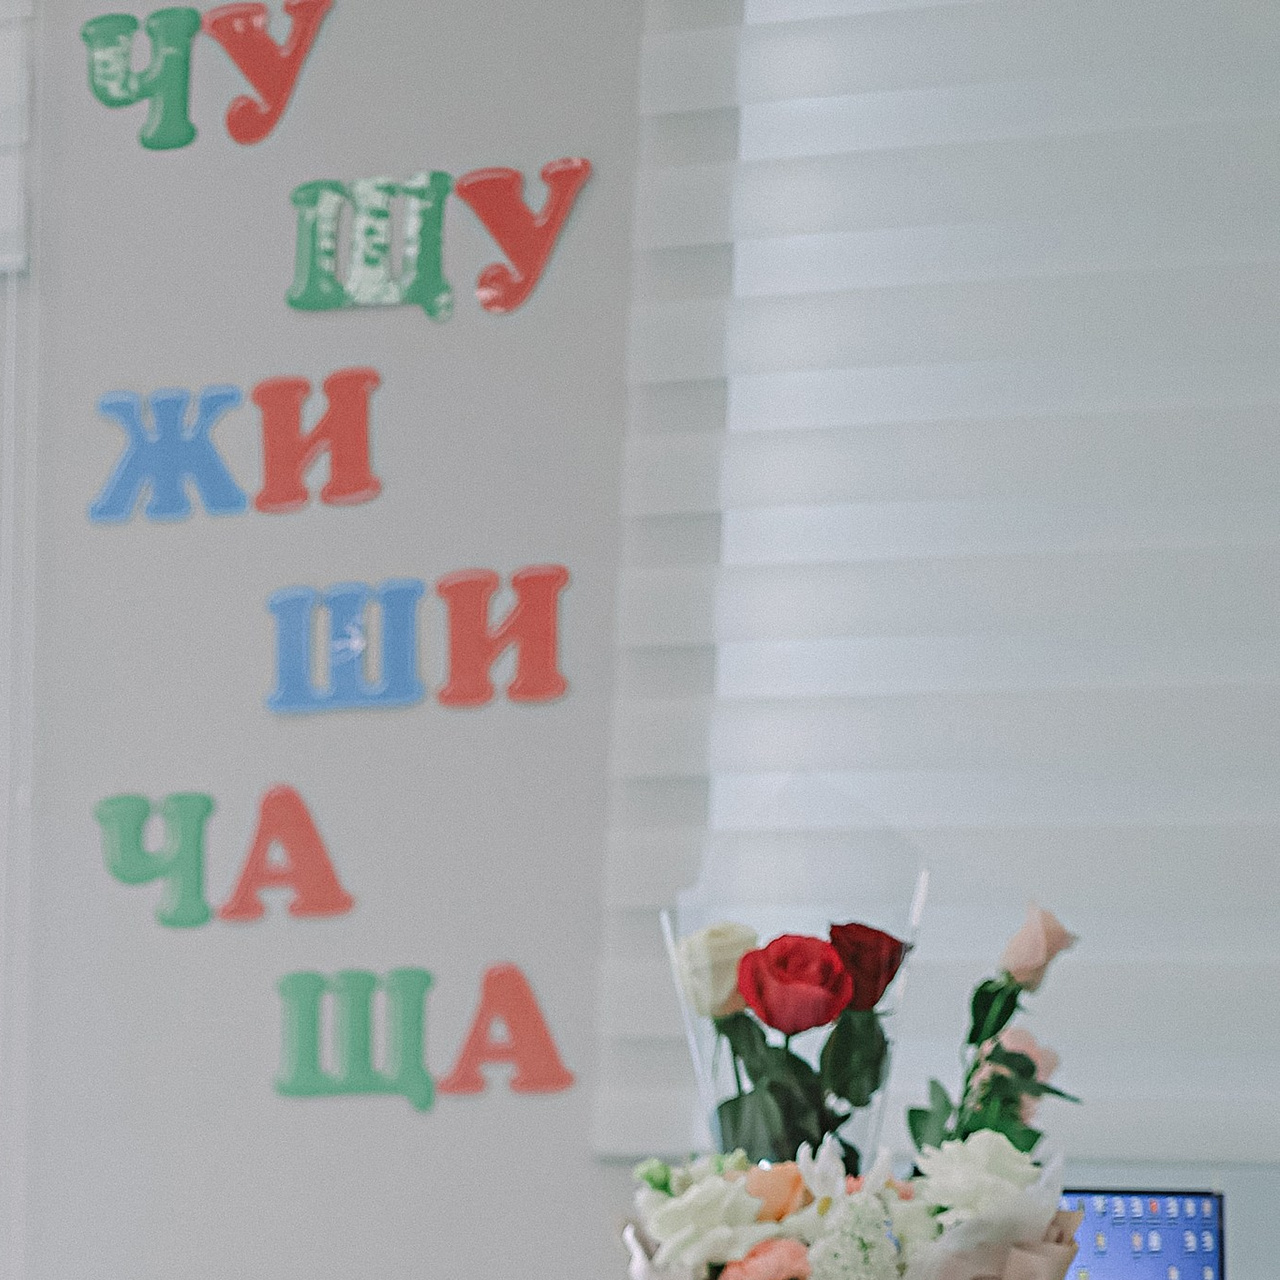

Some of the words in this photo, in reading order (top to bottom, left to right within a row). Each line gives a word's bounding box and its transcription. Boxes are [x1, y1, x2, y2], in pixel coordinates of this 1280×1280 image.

[80, 0, 334, 150] ЧУ
[285, 157, 592, 320] ЩУ
[87, 366, 382, 524] ЖИ
[264, 562, 571, 712] ШИ
[95, 784, 354, 928] ЧА
[275, 962, 575, 1112] ЩА
